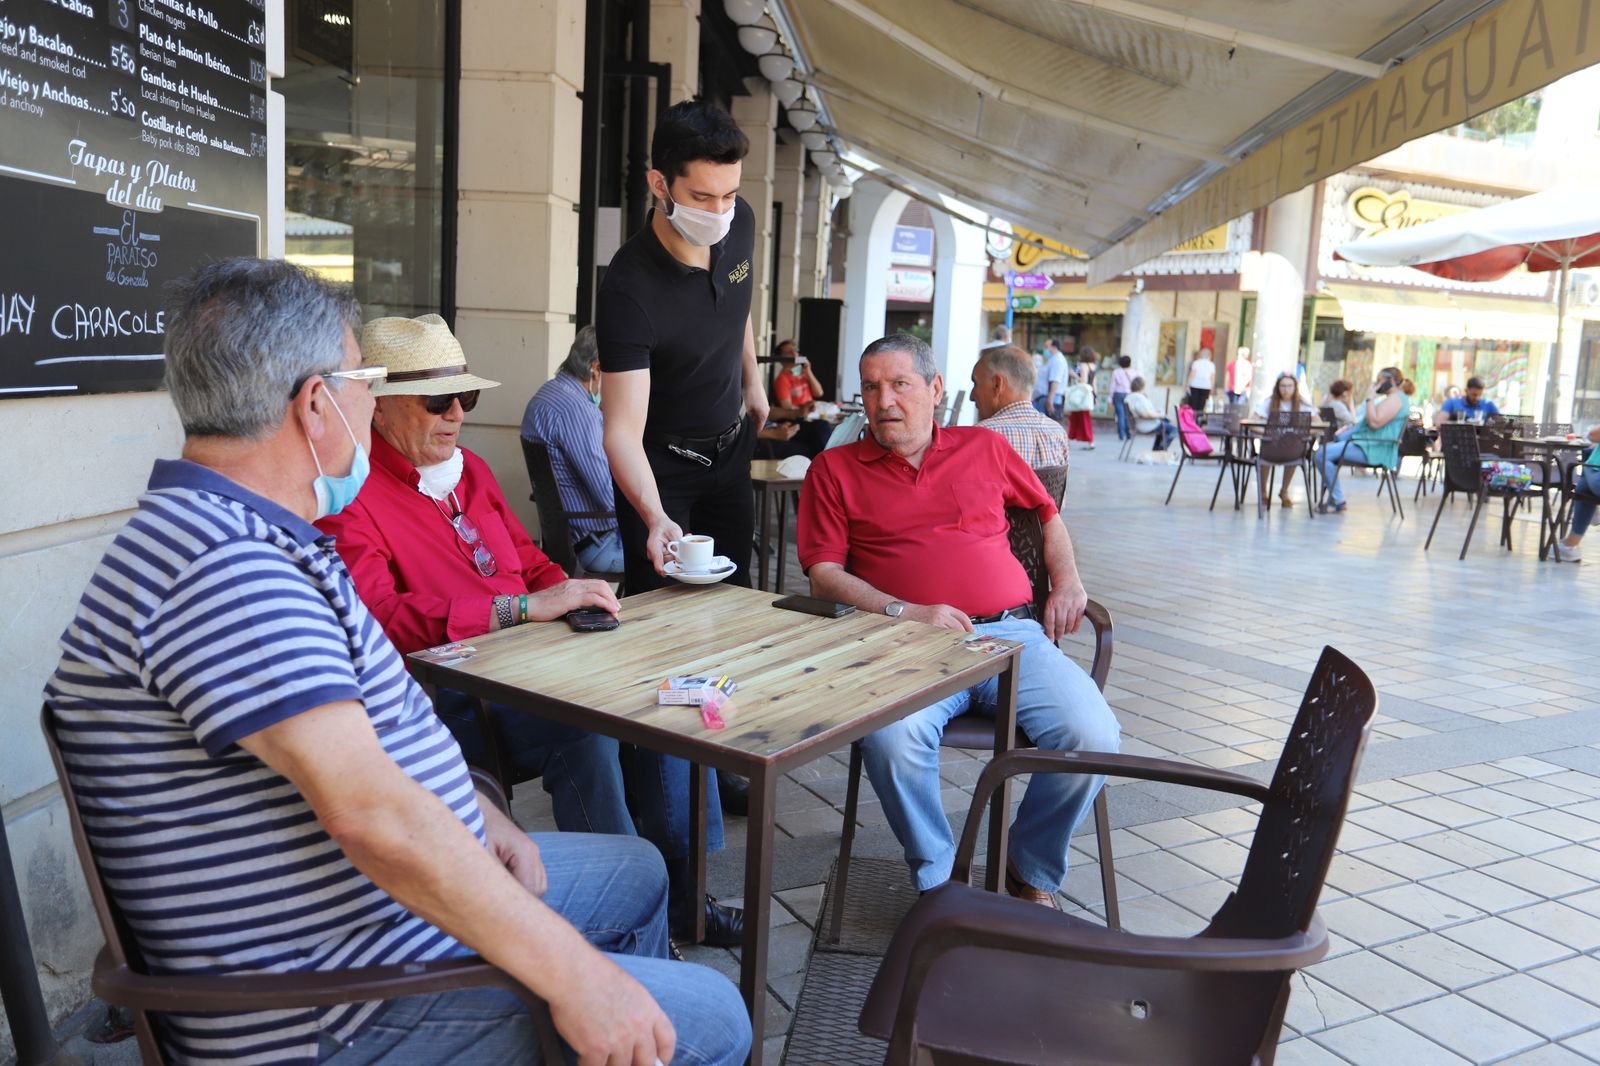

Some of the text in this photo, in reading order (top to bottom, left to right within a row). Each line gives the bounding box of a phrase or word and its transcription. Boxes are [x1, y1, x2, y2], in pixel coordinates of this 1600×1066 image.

[139, 0, 164, 19] Chicken
[186, 1, 196, 19] de
[198, 8, 218, 29] Pollo
[18, 27, 25, 44] y
[28, 26, 73, 56] Bacalao
[140, 23, 163, 46] Plato
[165, 34, 176, 52] de
[177, 40, 203, 64] Jamón
[205, 52, 231, 75] Ibérico
[20, 48, 36, 62] and
[39, 56, 69, 73] smoked
[72, 65, 86, 78] cod
[163, 51, 176, 68] ham
[32, 83, 39, 100] y
[42, 81, 89, 110] Anchoas
[141, 66, 218, 108] Gambas de Huelva
[141, 85, 158, 101] Local
[10, 97, 43, 117] anchovy
[141, 111, 175, 134] Costillar
[175, 121, 185, 137] de
[186, 125, 208, 144] Cerdo
[69, 139, 197, 192] Tapas y Platos
[106, 179, 131, 205] del
[107, 242, 157, 268] PARAISO
